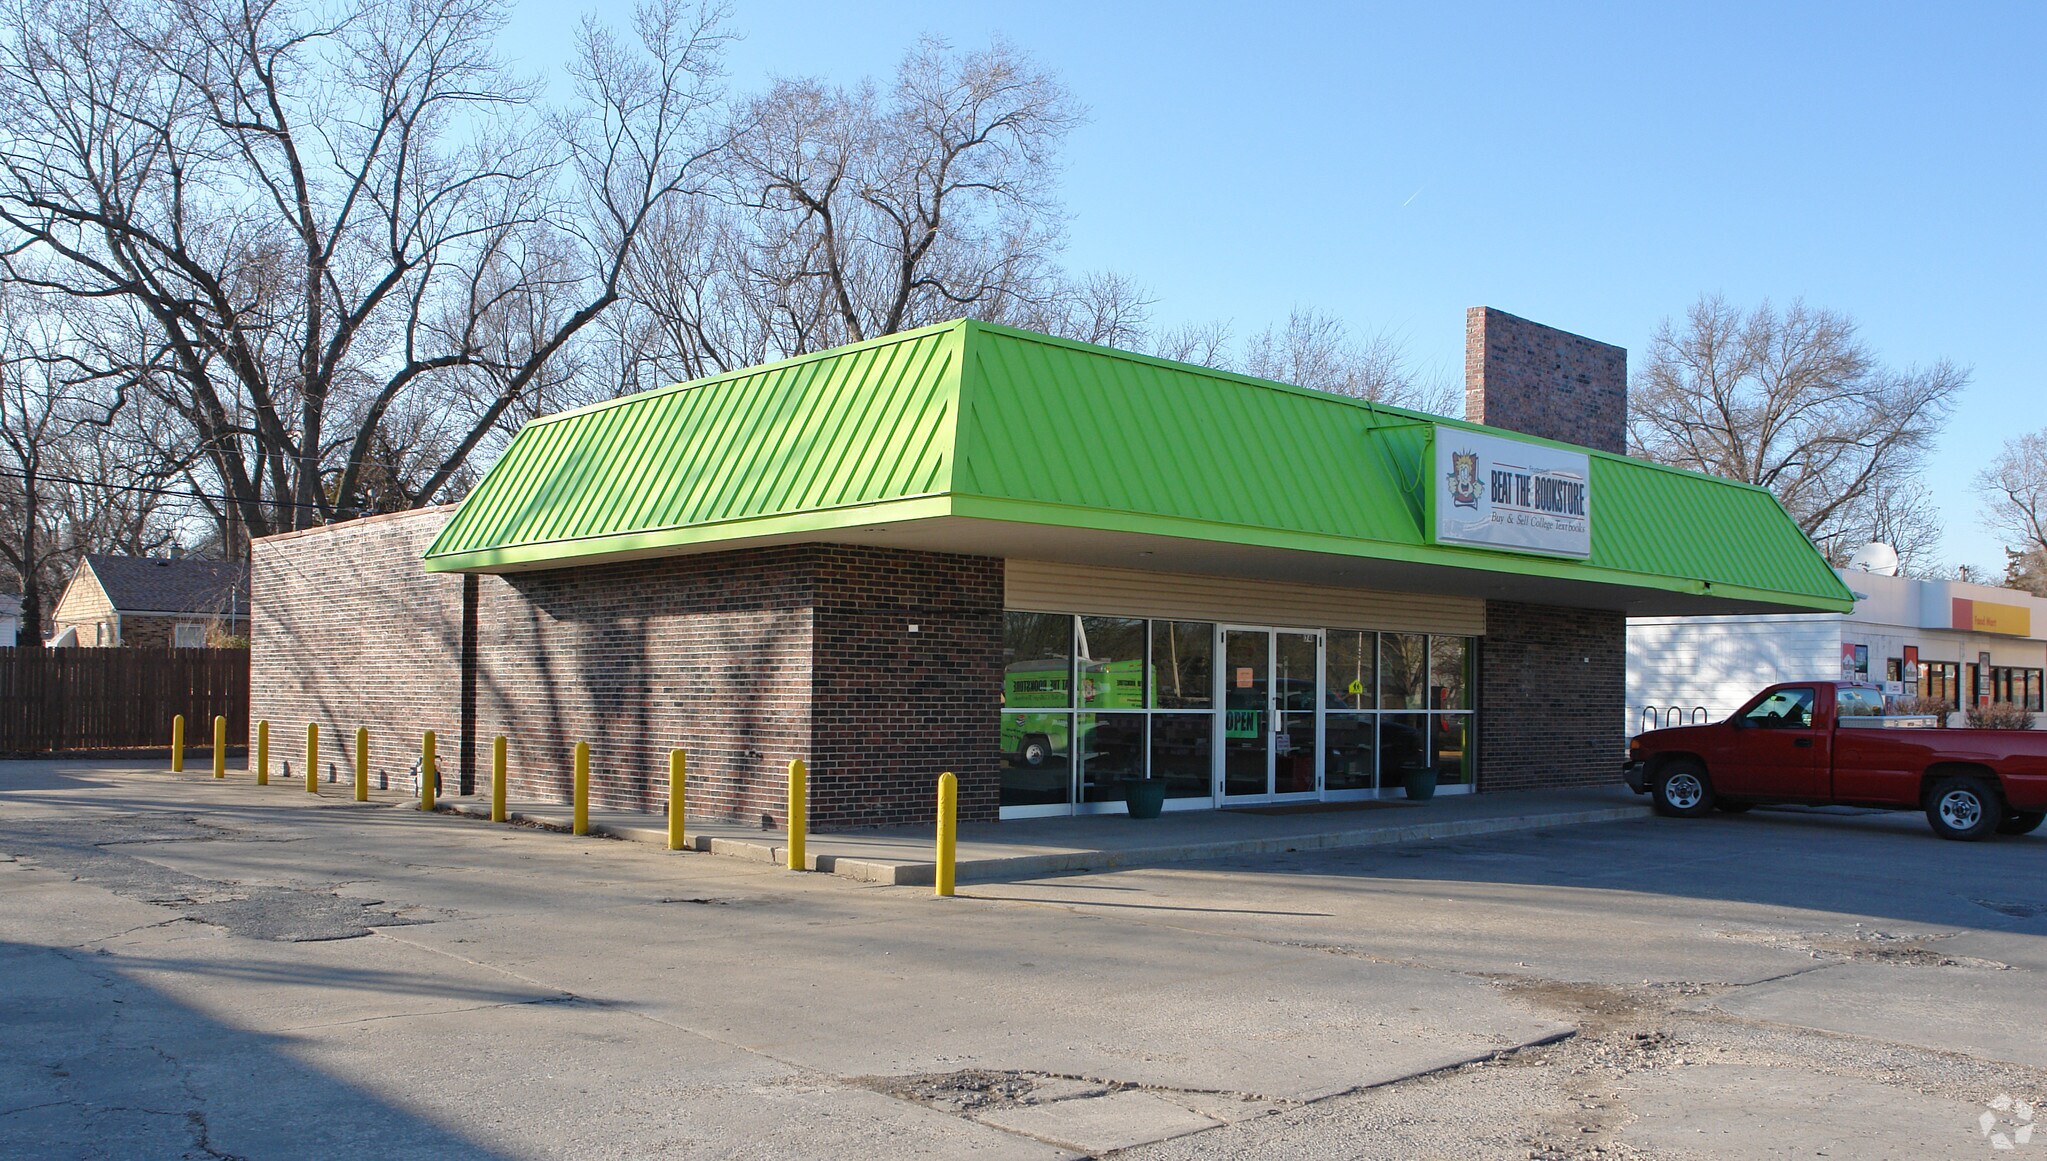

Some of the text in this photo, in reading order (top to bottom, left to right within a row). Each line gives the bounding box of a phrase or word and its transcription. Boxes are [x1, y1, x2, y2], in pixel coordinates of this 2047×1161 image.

[1491, 470, 1585, 516] BEAT THE BOOKSTORE
[1491, 512, 1585, 532] Buy & Sell College Textbooks
[1226, 711, 1253, 731] OPEN
